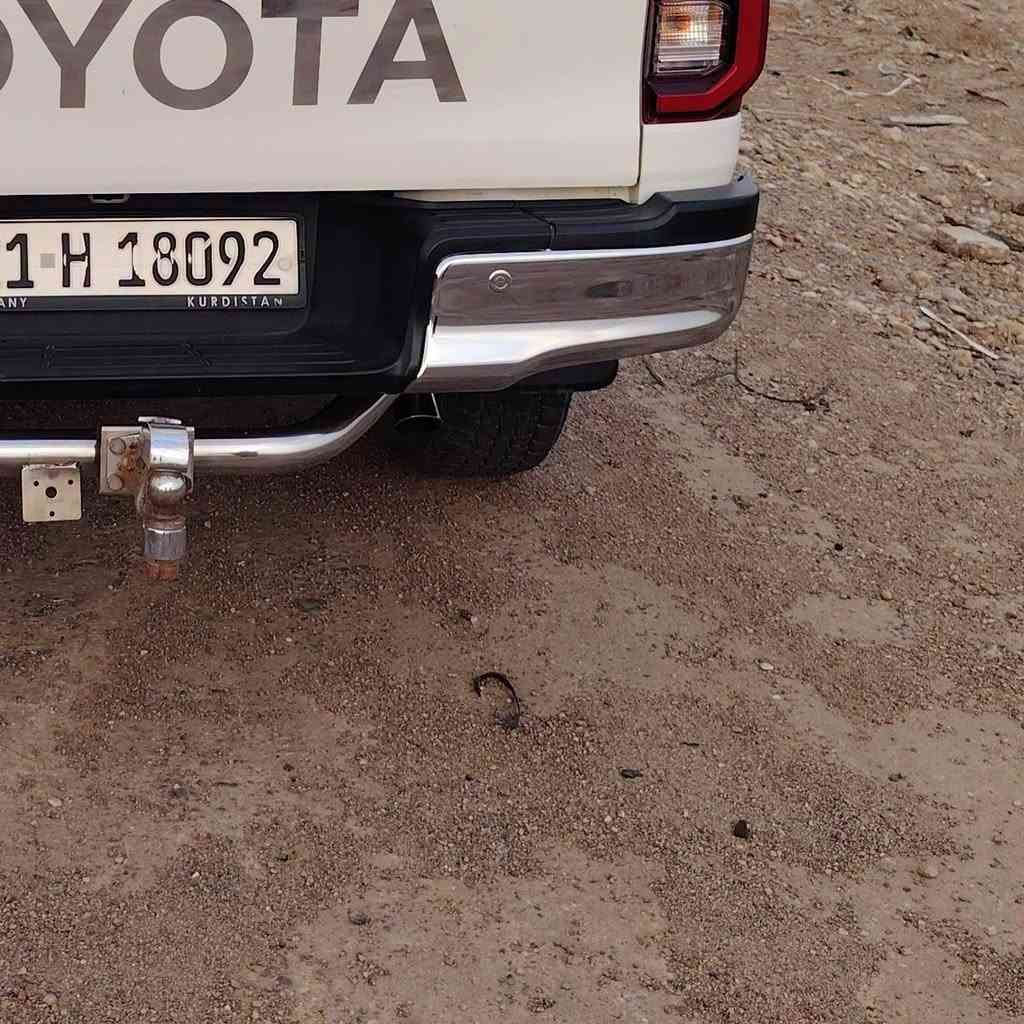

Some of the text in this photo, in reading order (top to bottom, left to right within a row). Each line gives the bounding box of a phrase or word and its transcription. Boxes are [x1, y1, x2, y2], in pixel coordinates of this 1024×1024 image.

[61, 232, 91, 288] H
[118, 231, 281, 287] 18092
[187, 295, 283, 307] KURDISTAN
